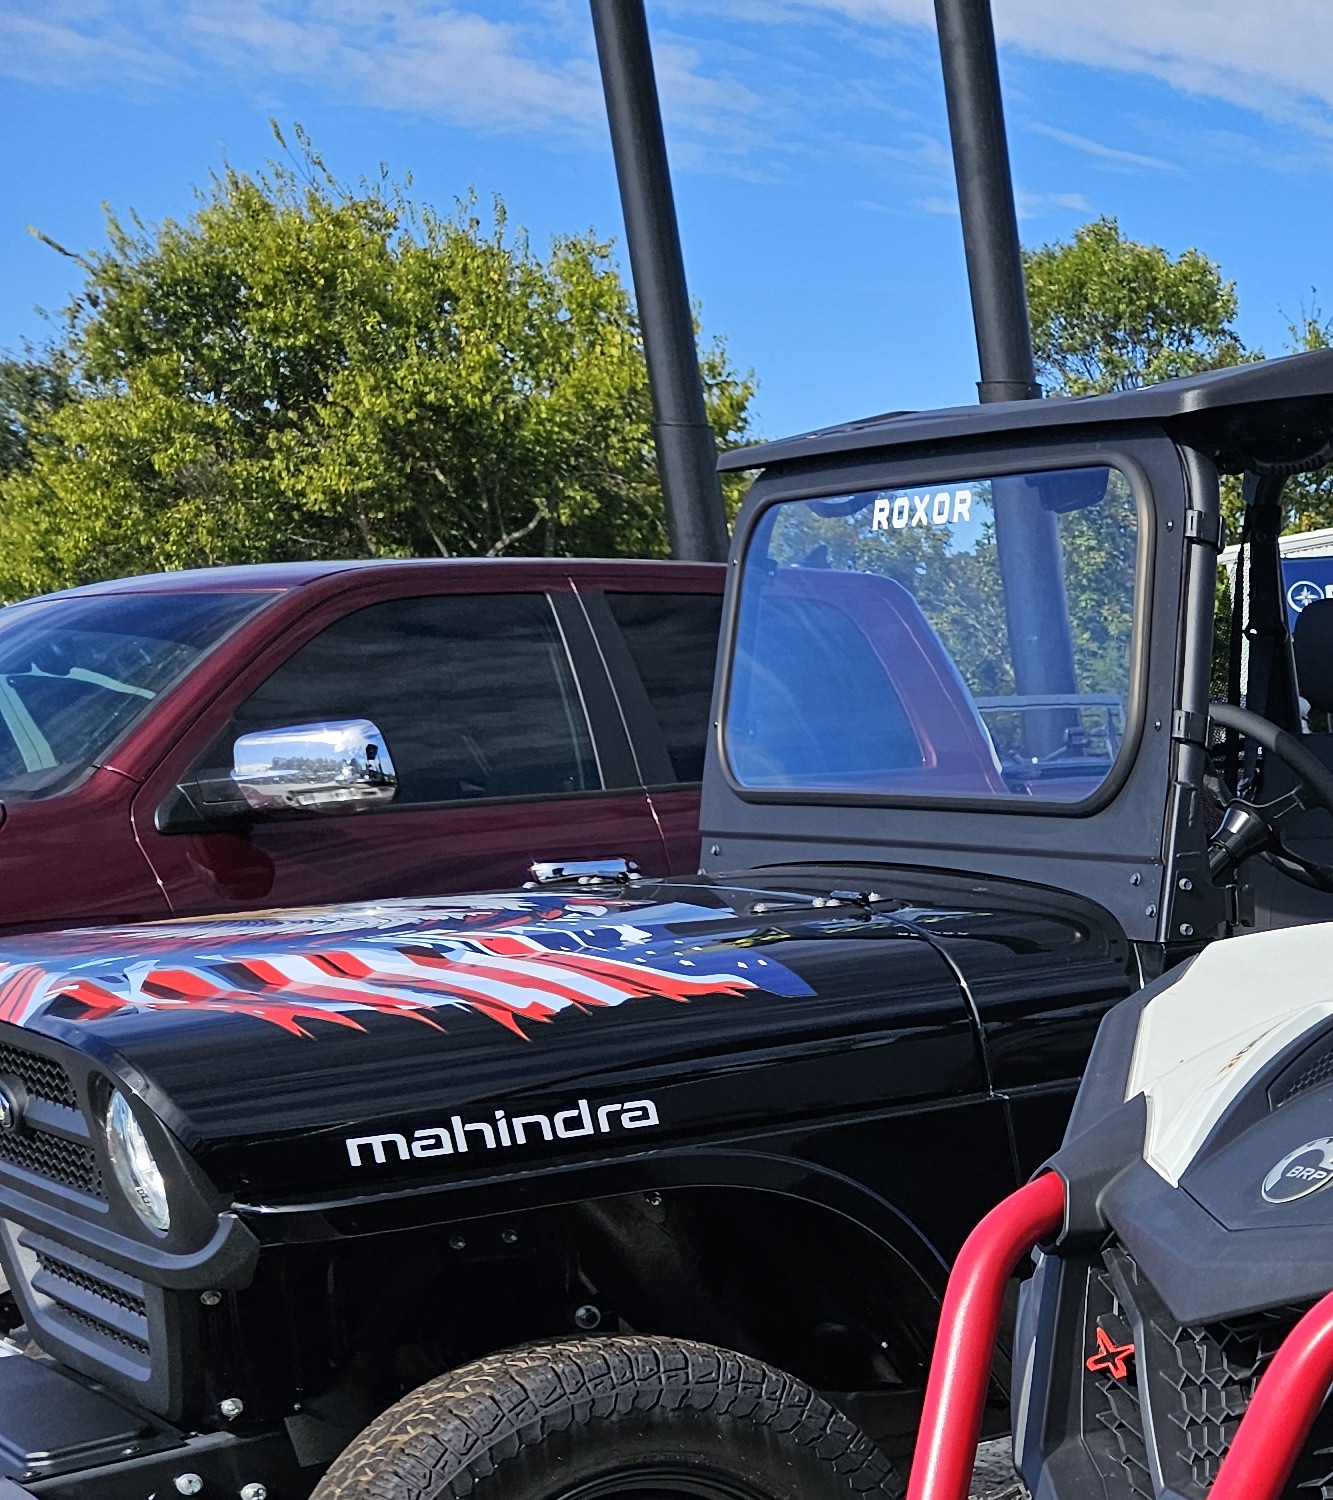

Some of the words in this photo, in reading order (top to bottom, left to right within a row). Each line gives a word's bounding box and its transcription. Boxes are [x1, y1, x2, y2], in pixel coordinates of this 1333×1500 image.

[872, 489, 972, 531] ROXOR
[345, 1099, 660, 1167] mahindra
[1286, 1165, 1328, 1182] BRP
